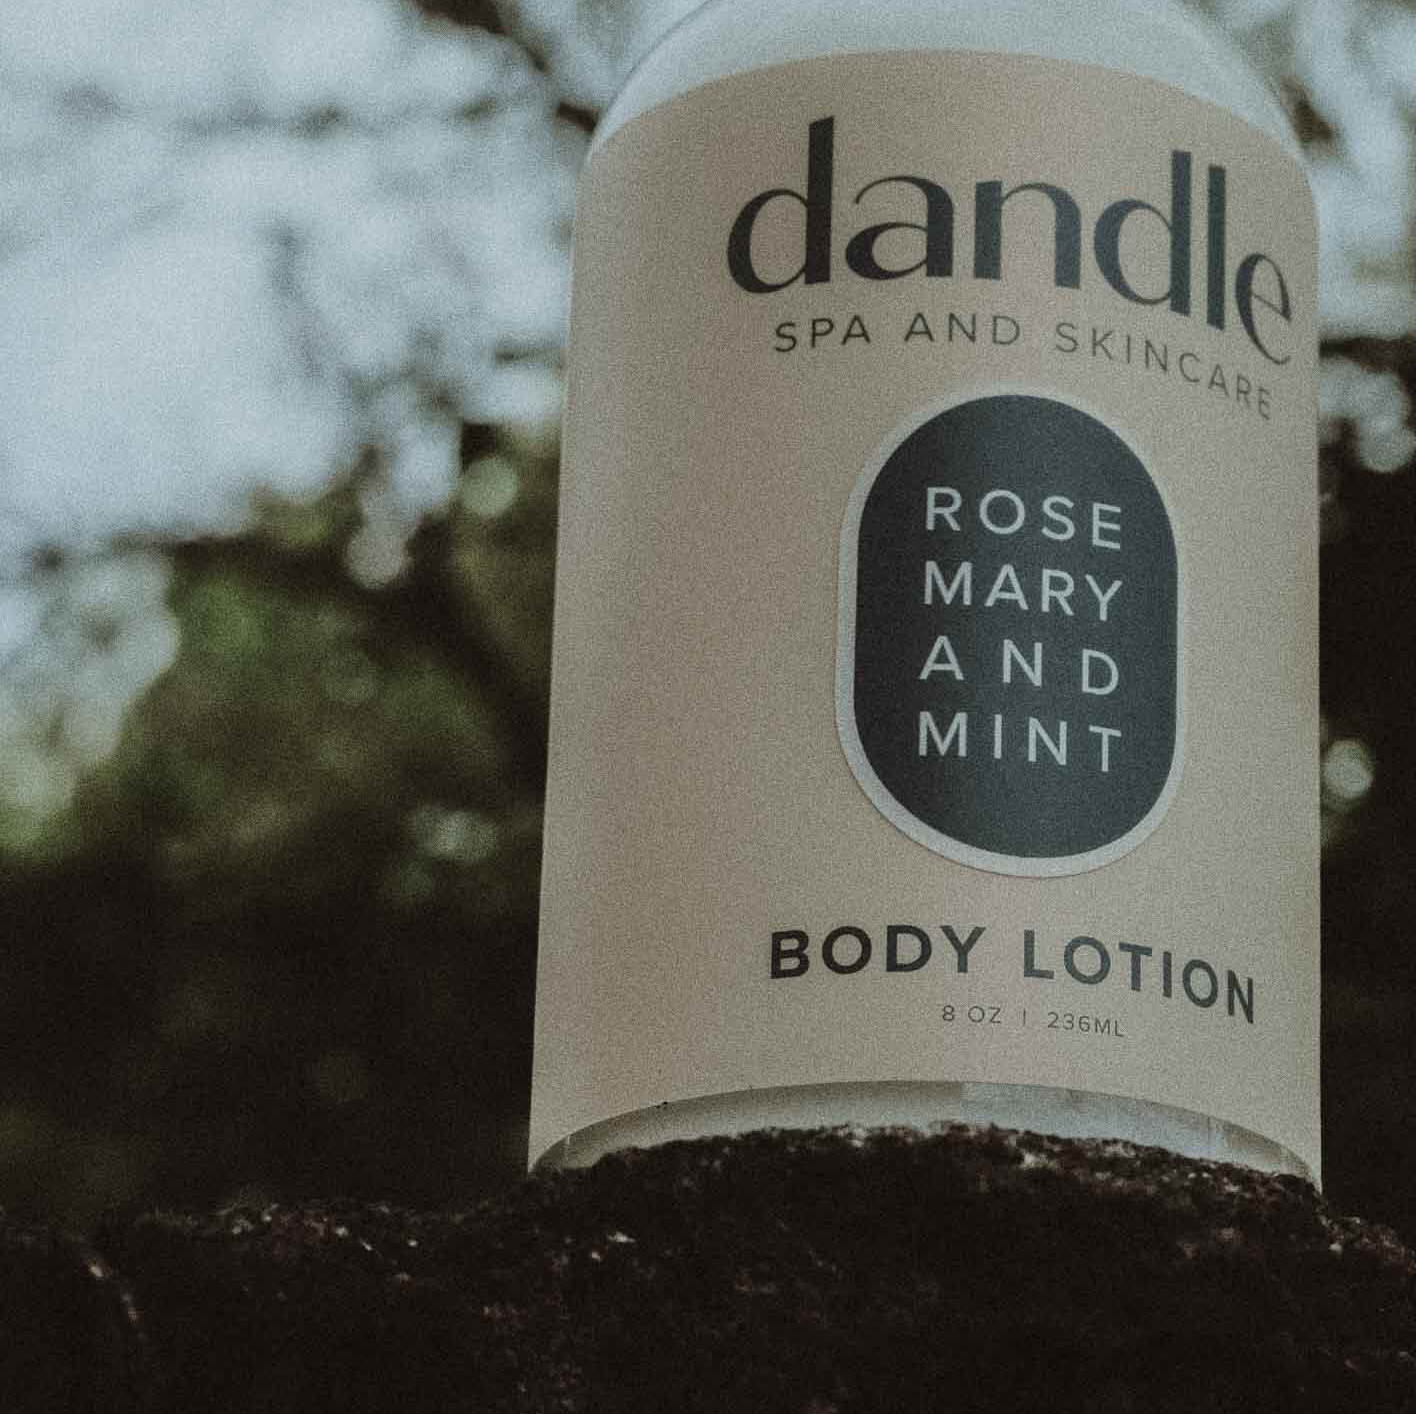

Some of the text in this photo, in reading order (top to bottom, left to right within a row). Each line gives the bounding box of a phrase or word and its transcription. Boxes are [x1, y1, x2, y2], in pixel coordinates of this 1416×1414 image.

[726, 115, 1292, 365] dandle
[773, 313, 1272, 420] SPA AND SKINCARE
[926, 486, 1121, 550] ROSE
[923, 560, 1123, 622] MARY
[919, 634, 1120, 696] AND
[917, 710, 1122, 773] MINT
[770, 924, 1254, 1024] BODY LOTION
[941, 1004, 956, 1023] 8
[967, 1005, 1002, 1025] OZ
[1047, 1012, 1125, 1038] 236ML
